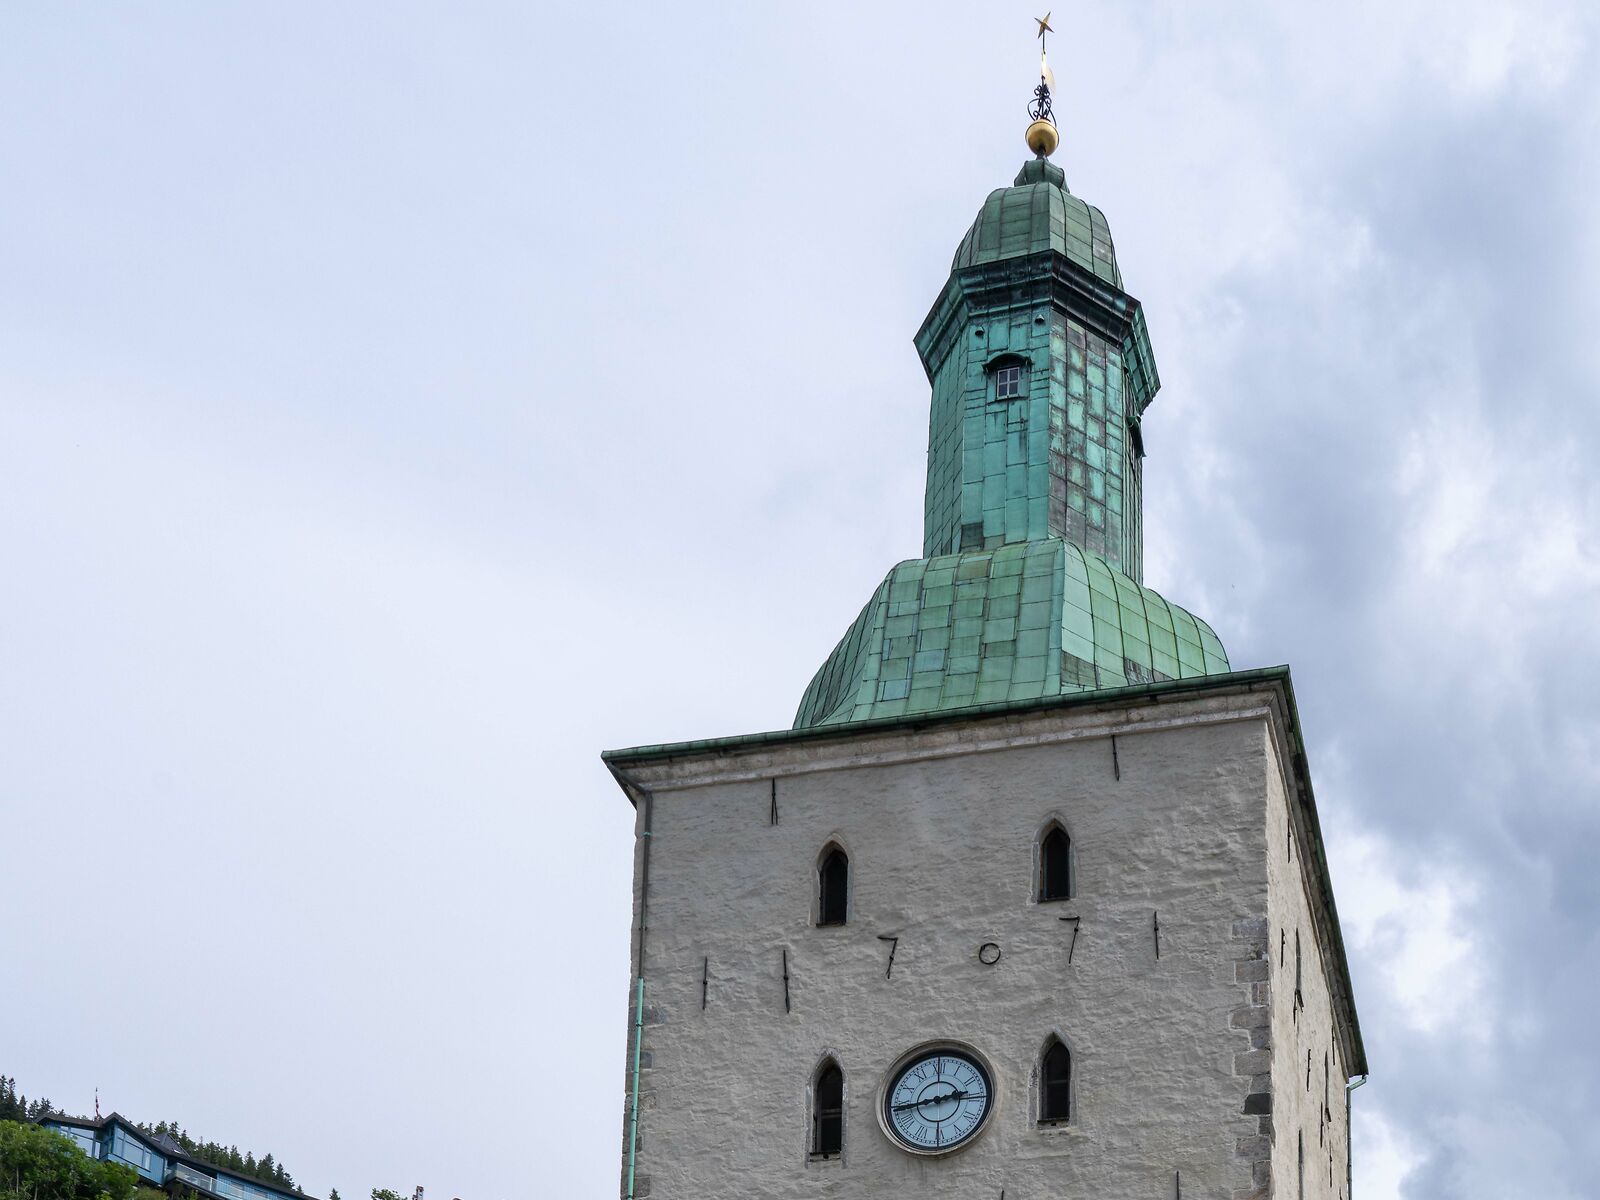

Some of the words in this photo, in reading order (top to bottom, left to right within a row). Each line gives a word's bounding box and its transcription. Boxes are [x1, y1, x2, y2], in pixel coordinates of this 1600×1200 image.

[913, 1068, 927, 1083] XI
[953, 1065, 960, 1077] I
[963, 1076, 976, 1087] II
[902, 1084, 915, 1094] X
[900, 1113, 915, 1130] VIII
[963, 1110, 976, 1123] IV
[915, 1125, 928, 1140] VII
[953, 1124, 961, 1135] V
